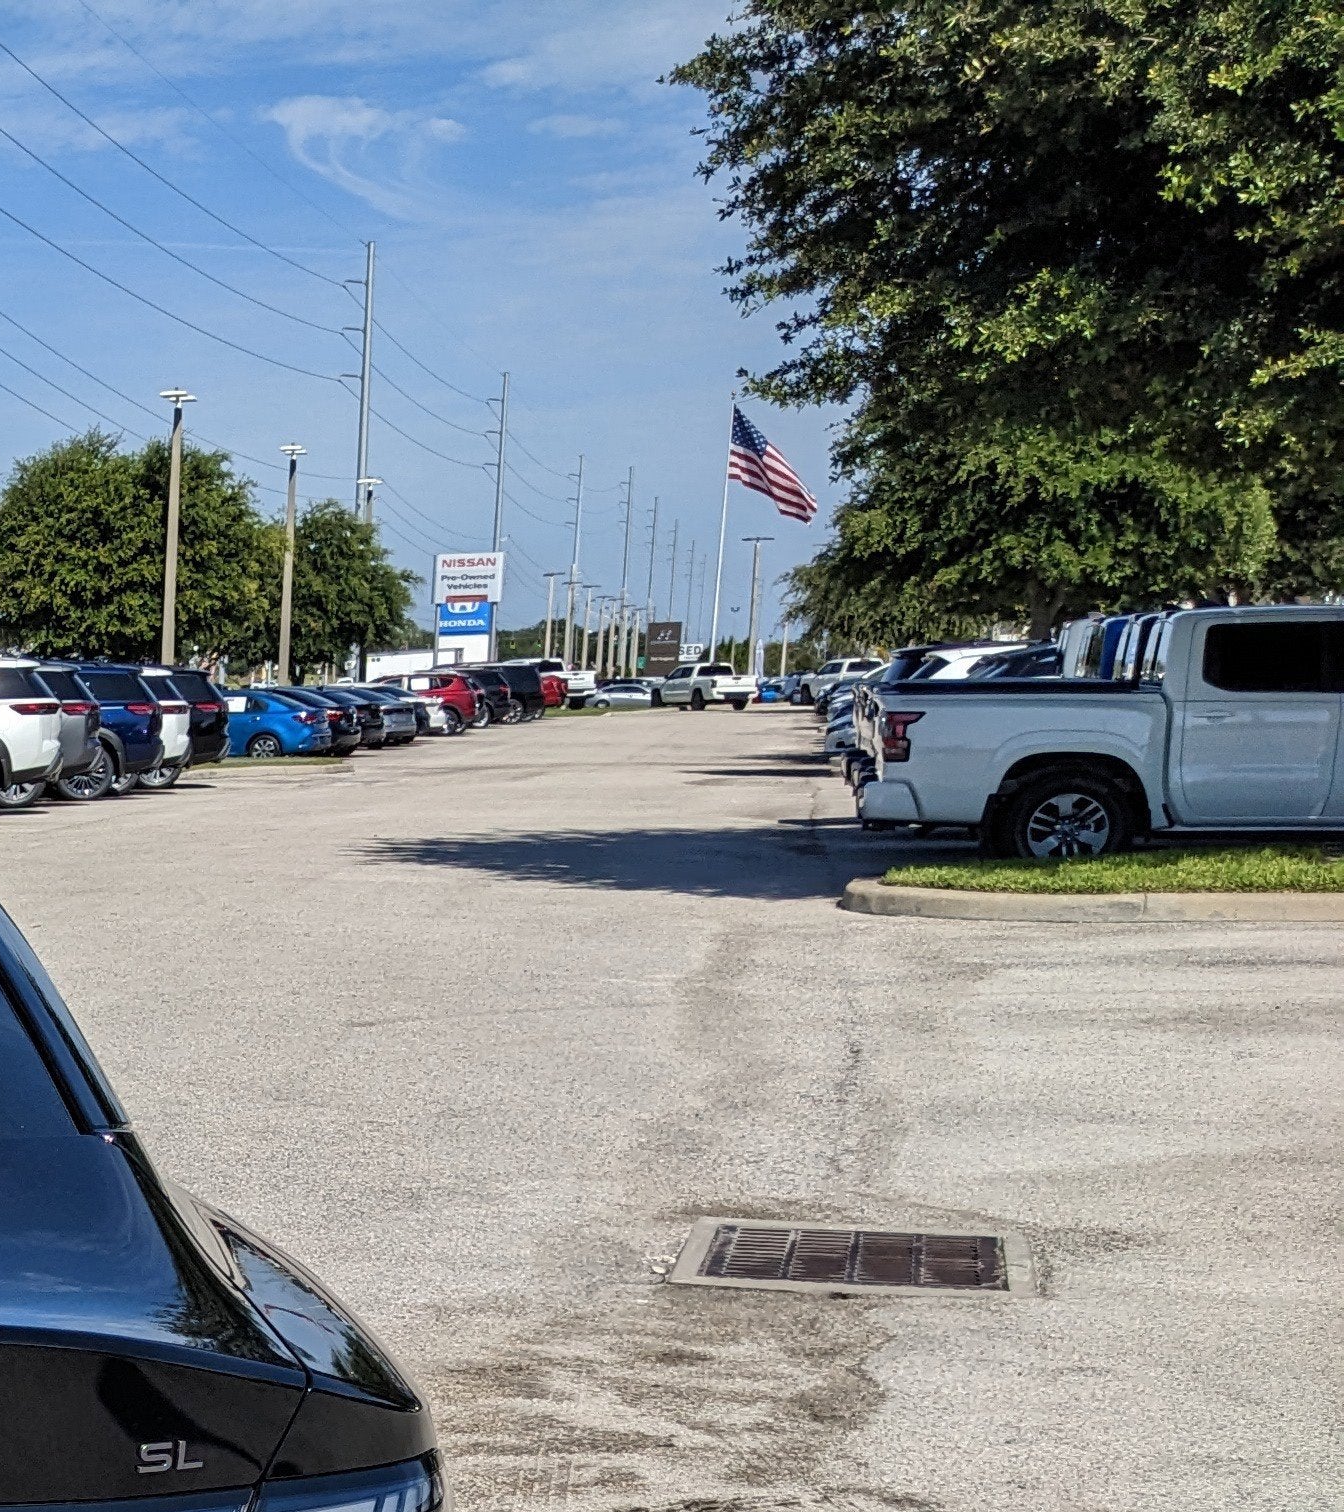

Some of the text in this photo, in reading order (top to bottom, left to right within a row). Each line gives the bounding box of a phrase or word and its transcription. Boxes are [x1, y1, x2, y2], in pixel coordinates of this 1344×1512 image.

[441, 557, 496, 568] NISSAN
[439, 619, 485, 627] HONDA
[679, 645, 701, 655] SED
[137, 1440, 203, 1473] SL
